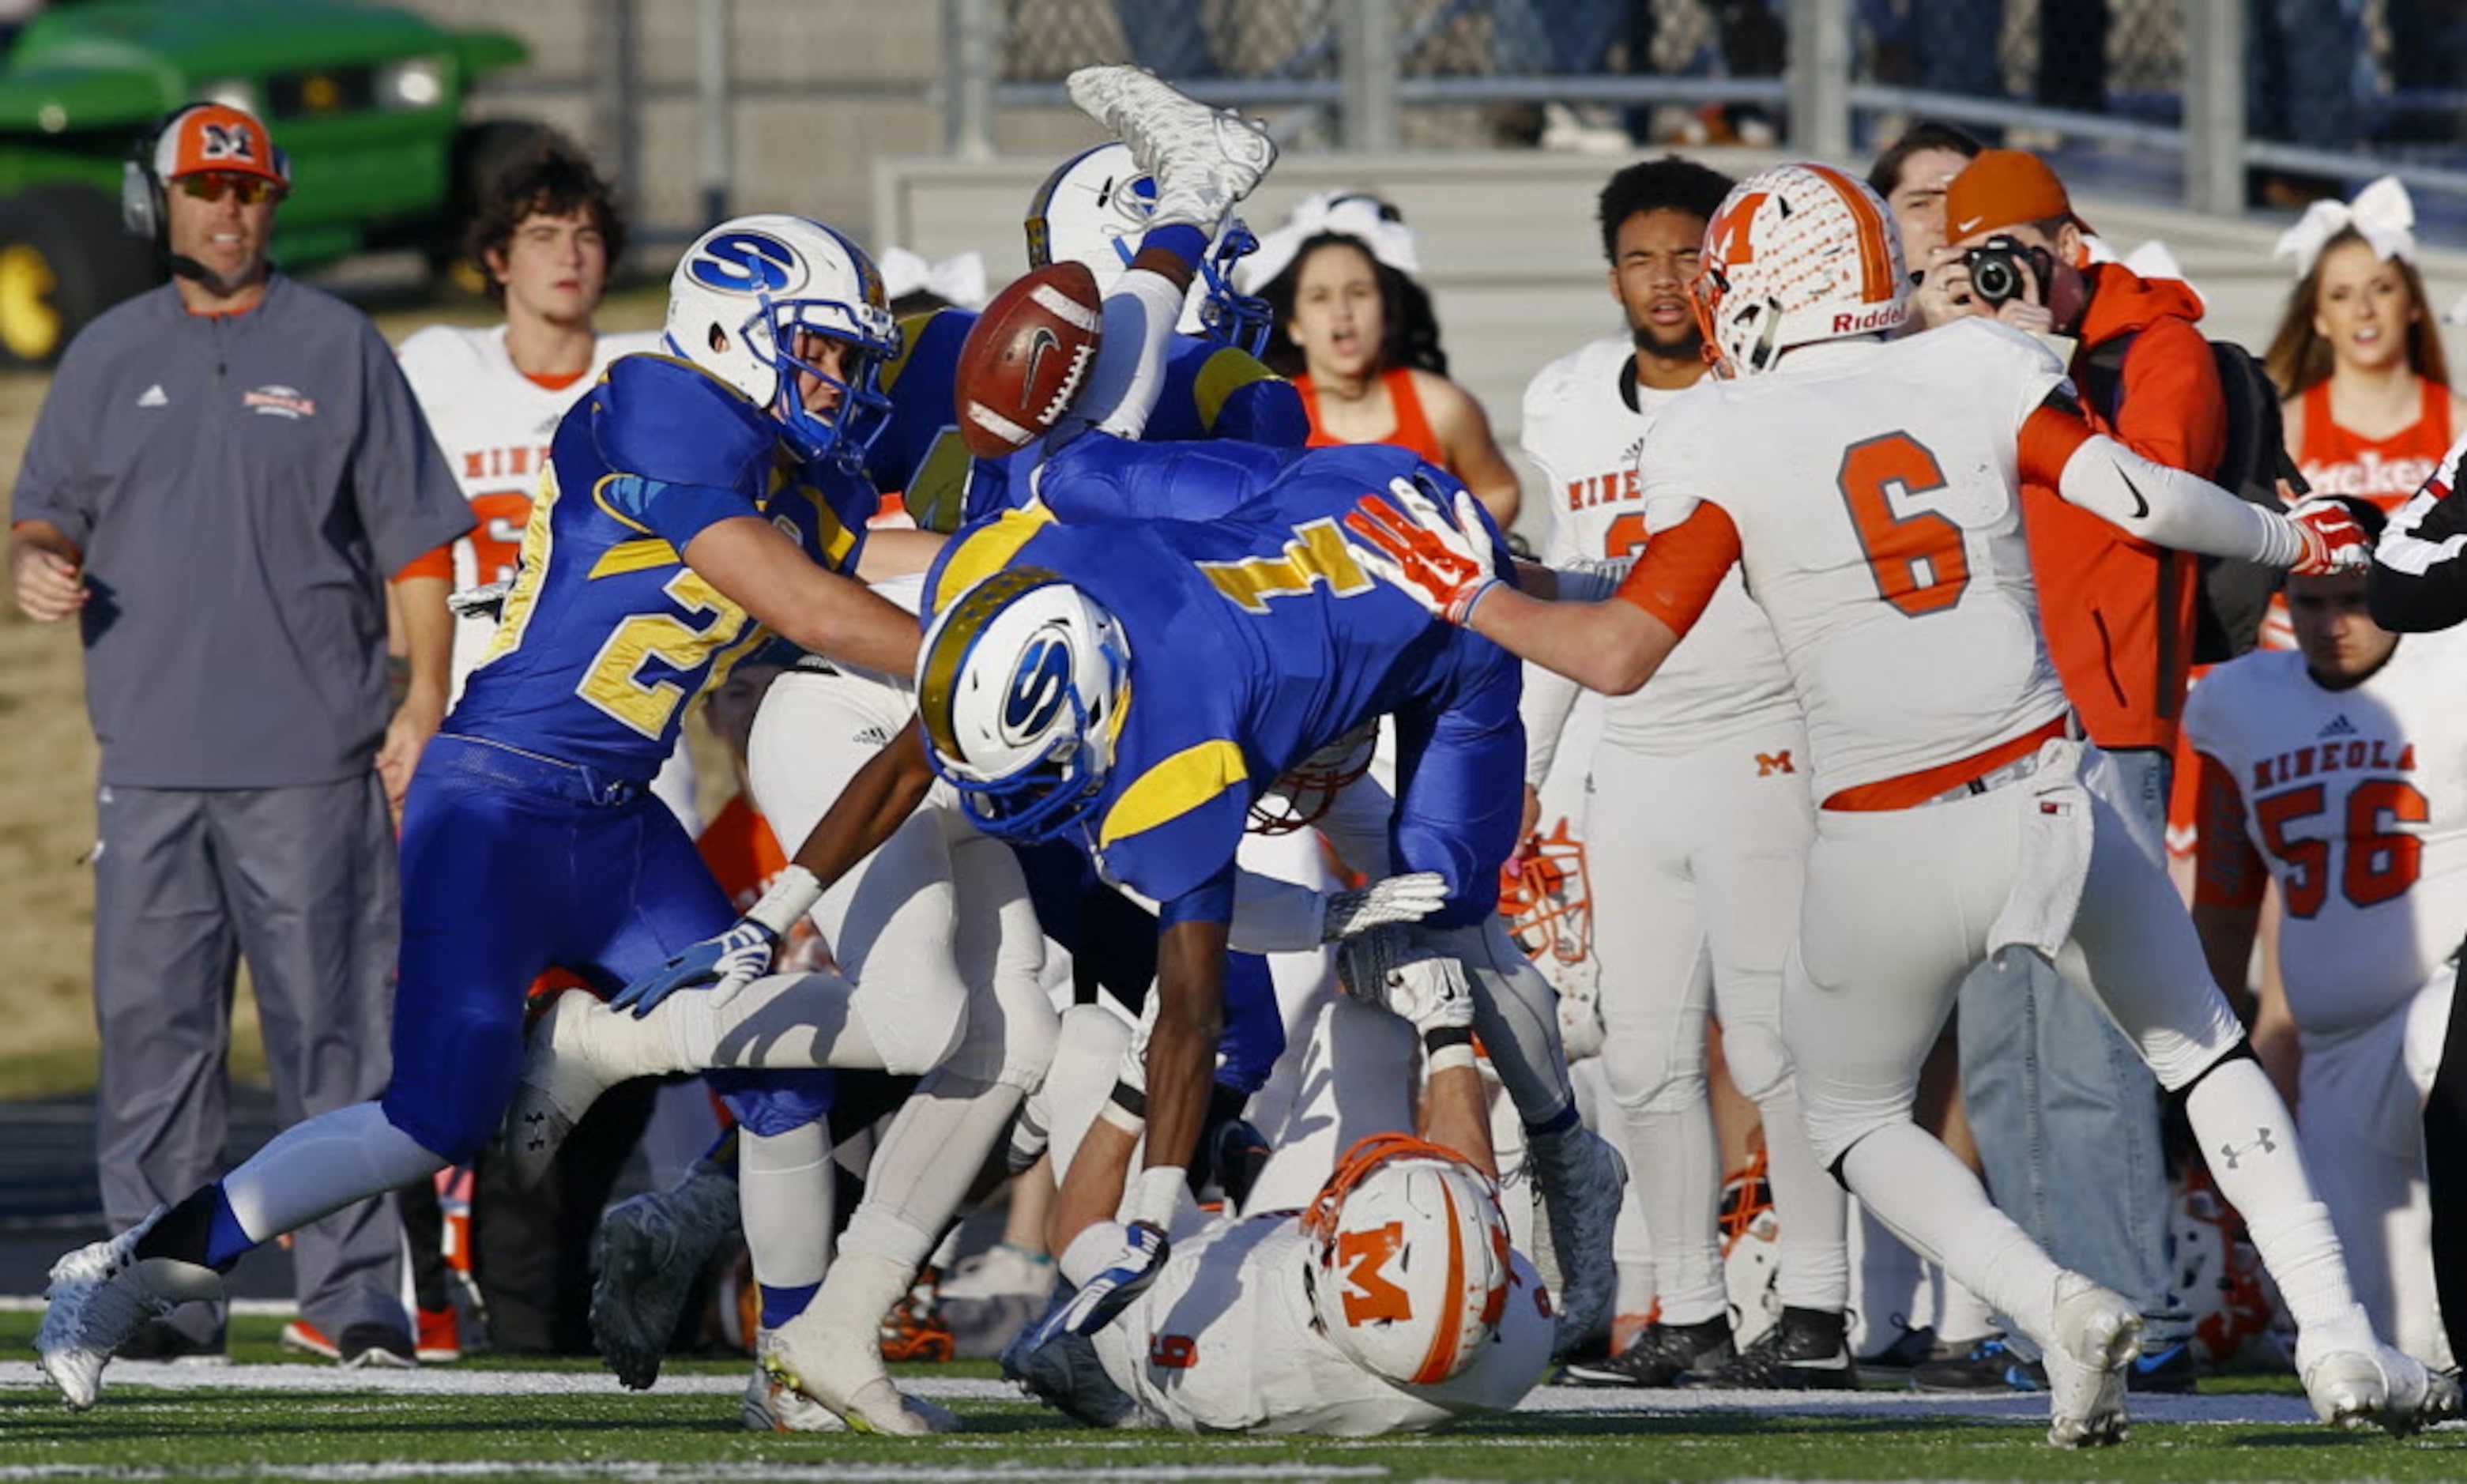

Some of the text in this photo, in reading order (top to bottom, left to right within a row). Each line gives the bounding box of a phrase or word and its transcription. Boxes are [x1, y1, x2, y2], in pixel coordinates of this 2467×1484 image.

[202, 124, 255, 164] M
[691, 234, 795, 293] S
[1838, 430, 1968, 618] 6
[1005, 638, 1072, 737] S
[1754, 749, 1797, 778] M
[2254, 740, 2416, 791] MINEOLA
[2254, 778, 2429, 919] 56
[1339, 1221, 1412, 1328] M
